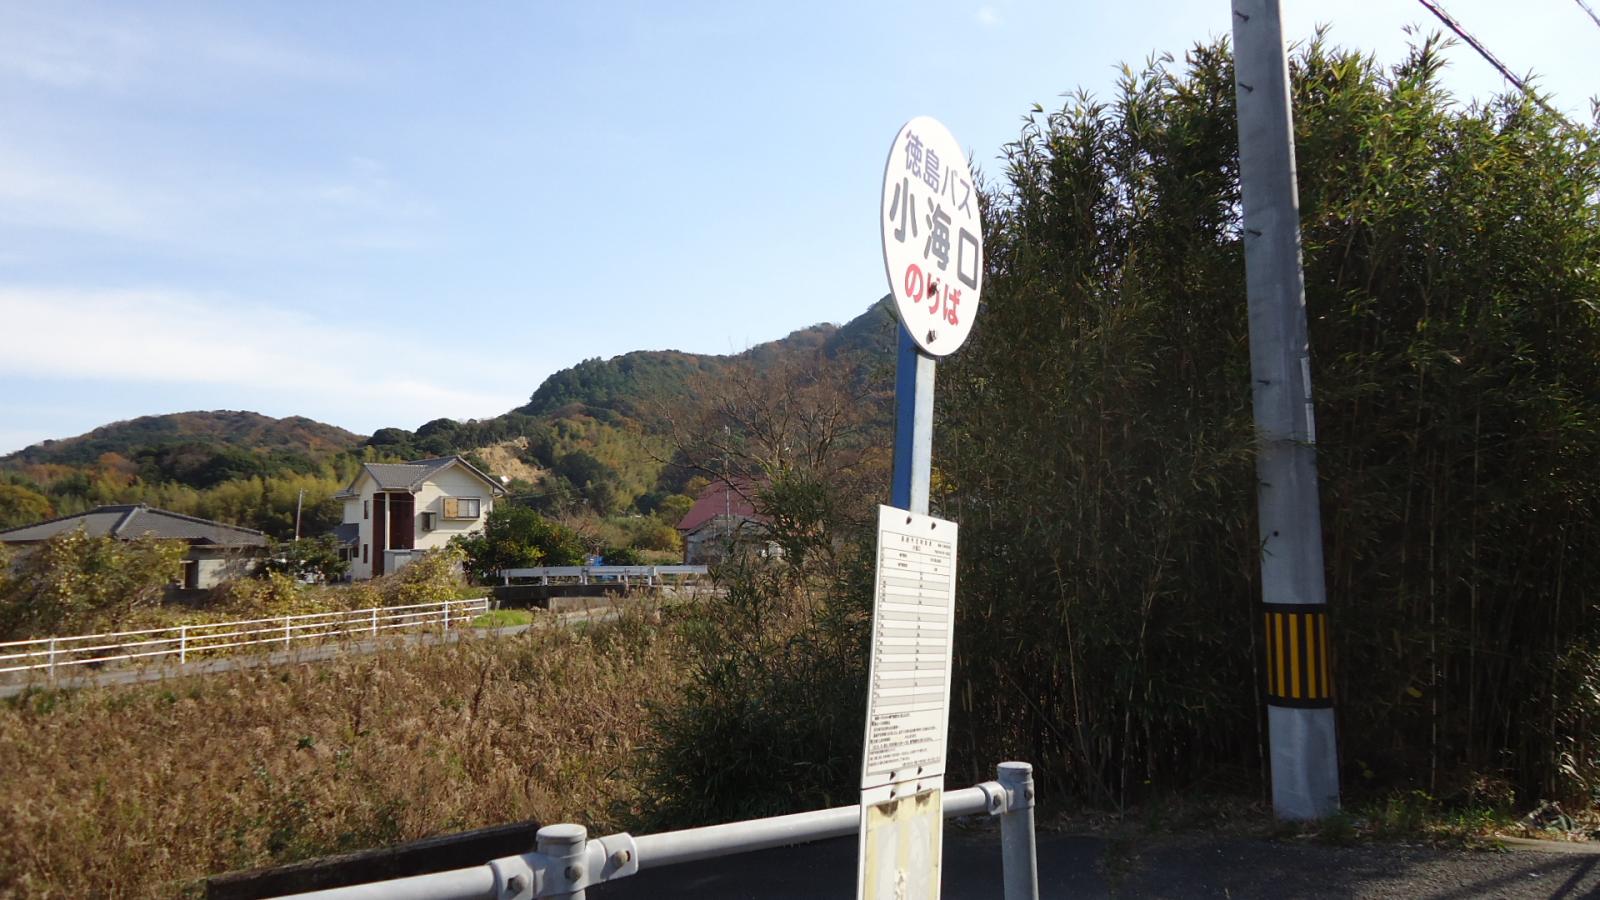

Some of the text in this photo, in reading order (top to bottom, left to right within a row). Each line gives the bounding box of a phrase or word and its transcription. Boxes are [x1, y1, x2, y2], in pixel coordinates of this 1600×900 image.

[905, 129, 972, 220] 徳島バス
[889, 177, 979, 291] 小海口
[904, 263, 962, 326] のりば
